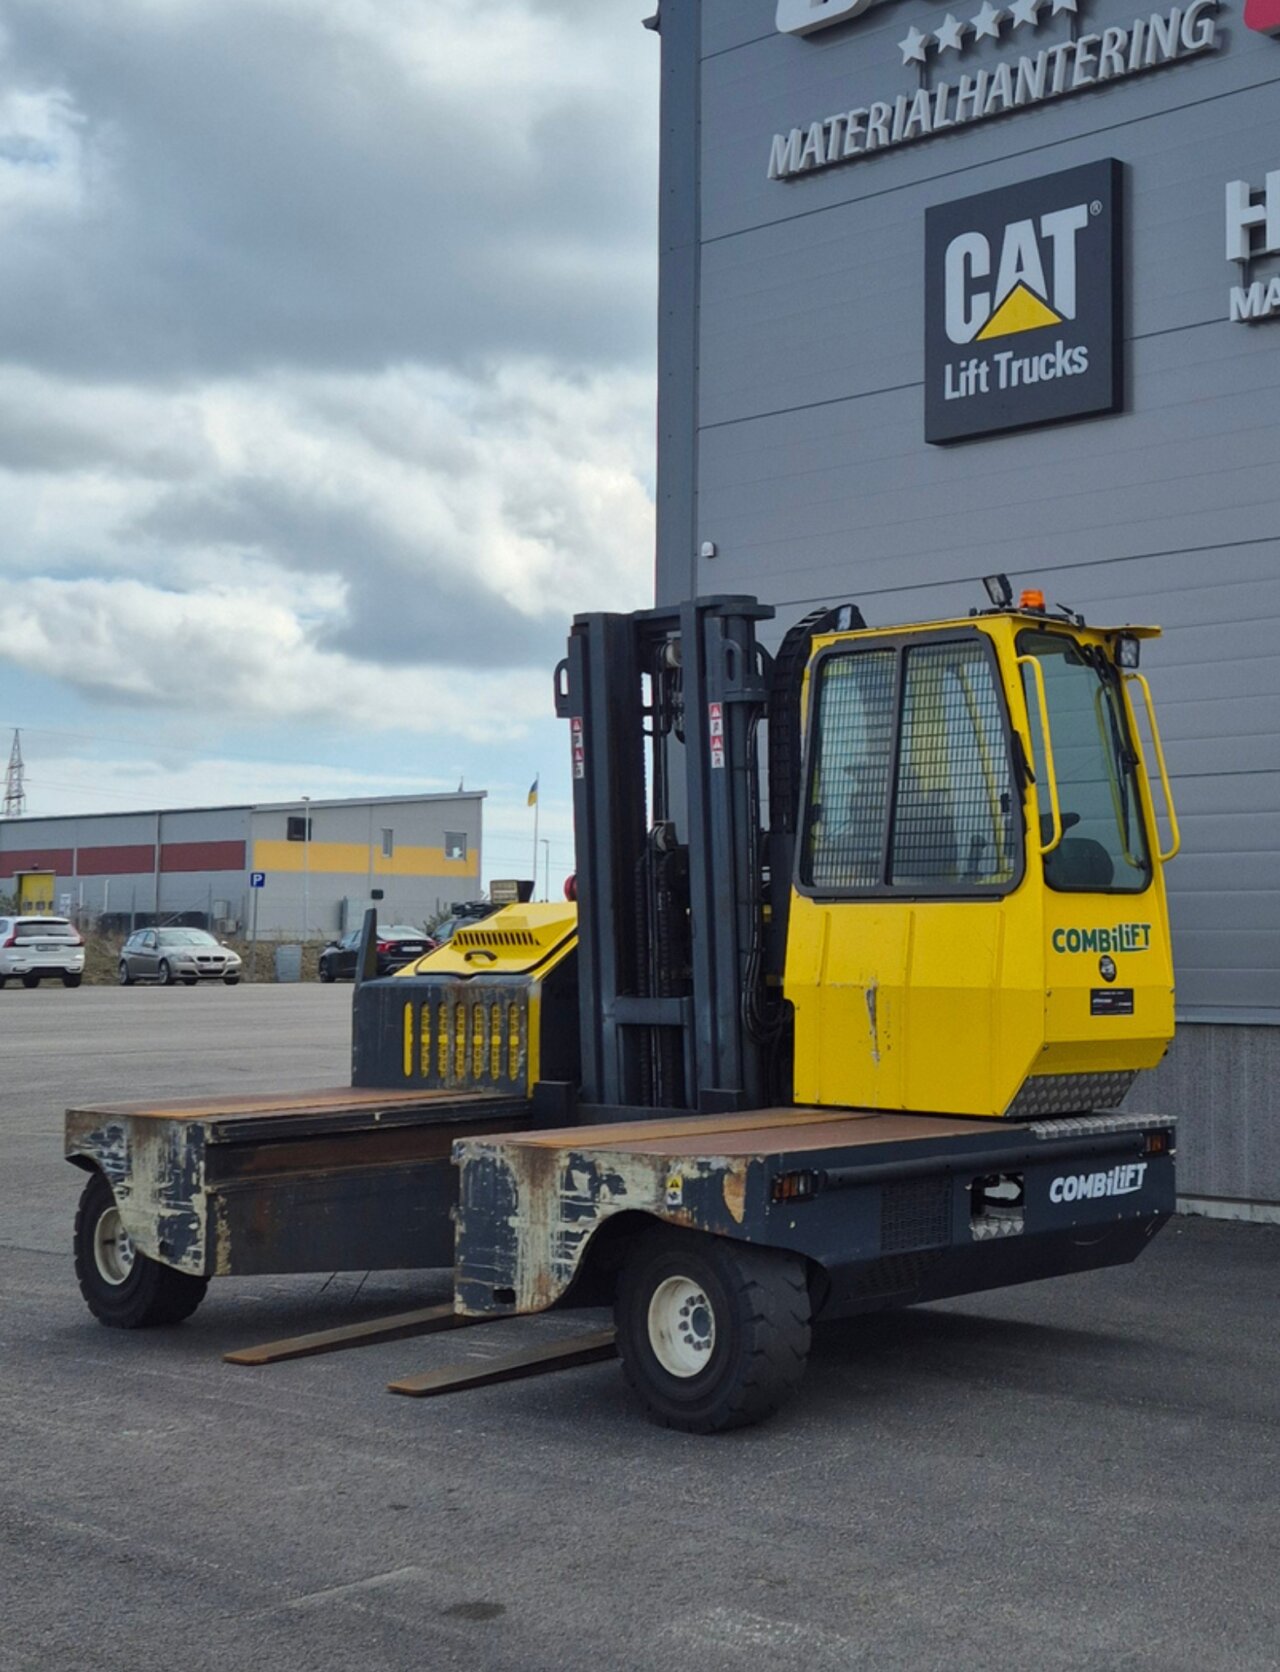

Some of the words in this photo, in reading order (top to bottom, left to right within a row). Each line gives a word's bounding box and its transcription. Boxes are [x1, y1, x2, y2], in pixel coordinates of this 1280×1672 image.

[767, 0, 1219, 180] MATERIALHANTERING
[945, 358, 989, 400] Lift
[994, 340, 1089, 390] Trucks
